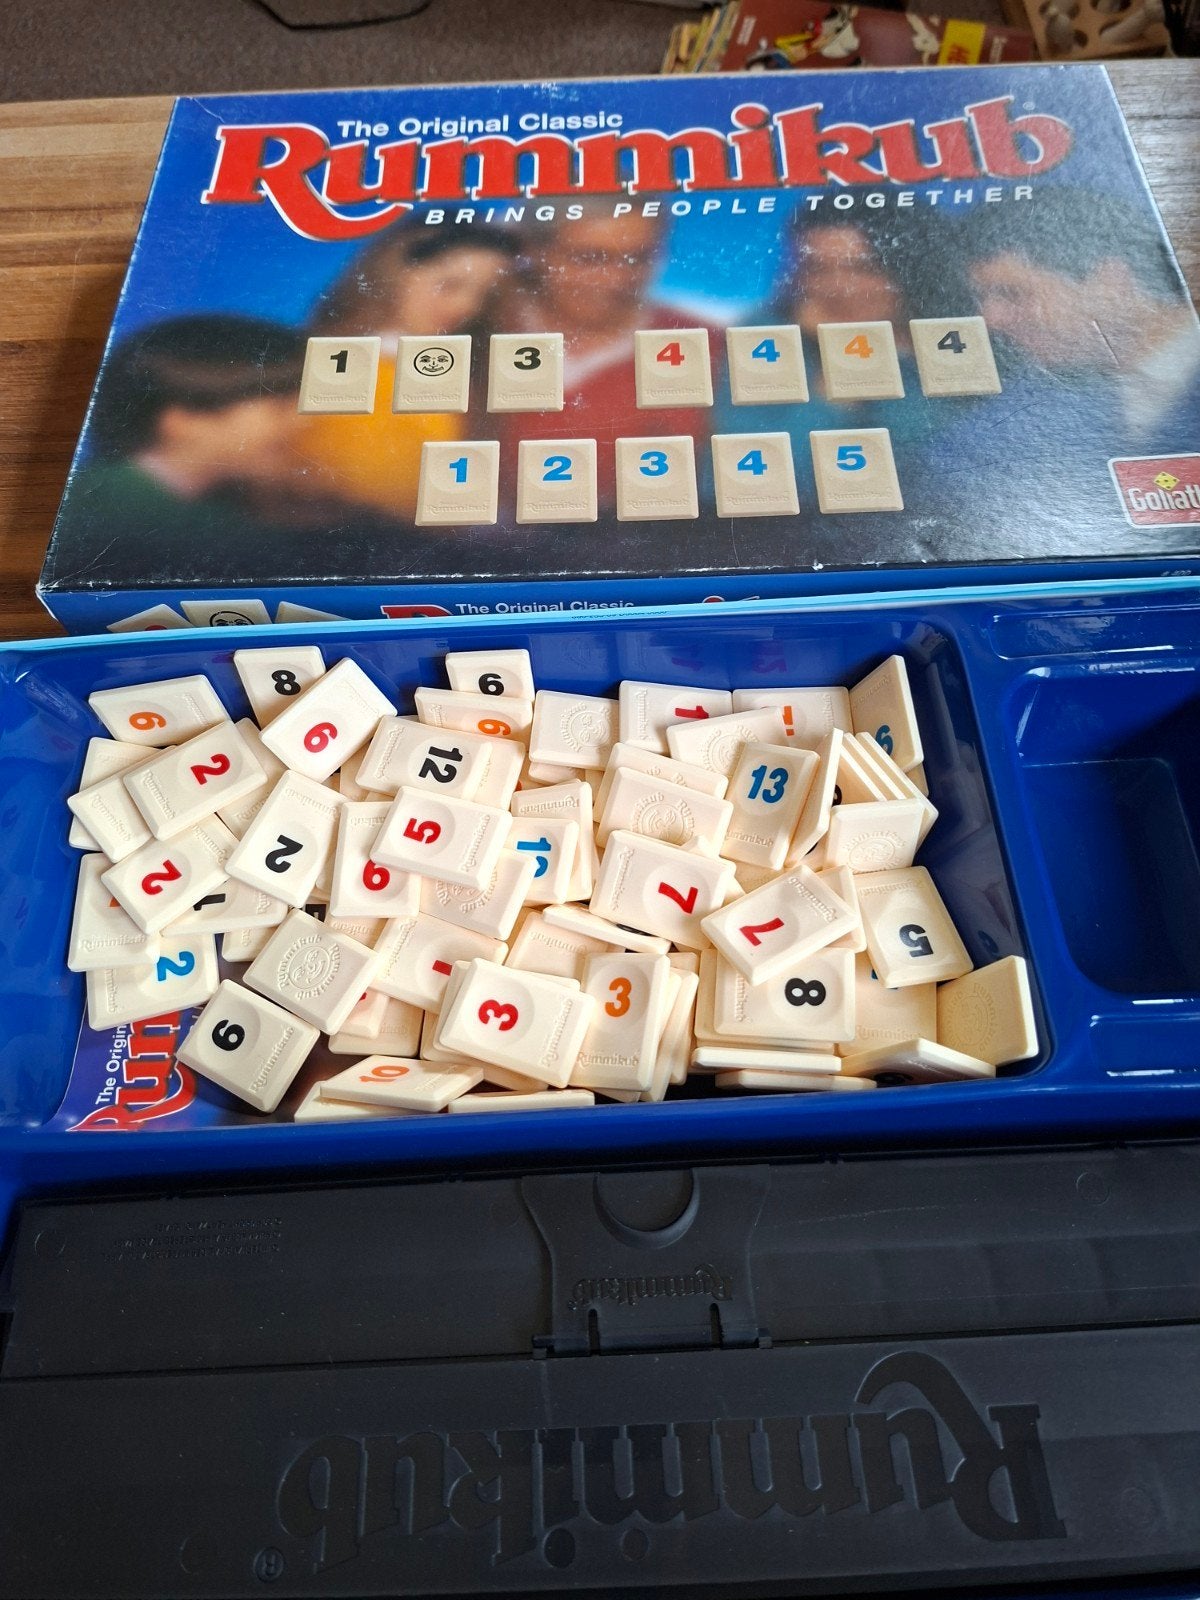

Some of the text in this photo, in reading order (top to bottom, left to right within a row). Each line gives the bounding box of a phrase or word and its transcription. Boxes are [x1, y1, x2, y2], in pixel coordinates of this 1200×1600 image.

[337, 111, 624, 139] The Original Classic
[201, 96, 1073, 241] Rummikub
[425, 186, 1035, 225] BRINGS PEOPLE TOGETHER
[656, 342, 685, 366] 4
[751, 339, 780, 362] 4
[844, 335, 874, 359] 4
[937, 330, 967, 354] 4
[330, 350, 349, 373] 1
[513, 347, 541, 370] 3
[449, 457, 468, 483] 1
[543, 455, 572, 481] 2
[639, 451, 669, 477] 3
[737, 450, 767, 476] 4
[837, 446, 866, 471] 5
[455, 603, 490, 615] The
[271, 669, 302, 696] 8
[190, 753, 231, 785] 2
[418, 746, 463, 784] 12
[748, 765, 789, 804] 13
[403, 818, 442, 845] 5
[265, 834, 304, 874] 2
[141, 859, 182, 896] 2
[658, 882, 699, 915] 7
[740, 917, 785, 947] 7
[899, 923, 934, 958] 5
[156, 951, 195, 982] 2
[604, 977, 633, 1018] 3
[784, 977, 827, 1007] 8
[478, 999, 519, 1032] 3
[95, 1025, 128, 1105] The Origin
[251, 1024, 296, 1094] Rummikub
[359, 1065, 410, 1083] 10
[572, 1264, 734, 1307] Rummikub
[279, 1350, 1068, 1574] Rummikub
